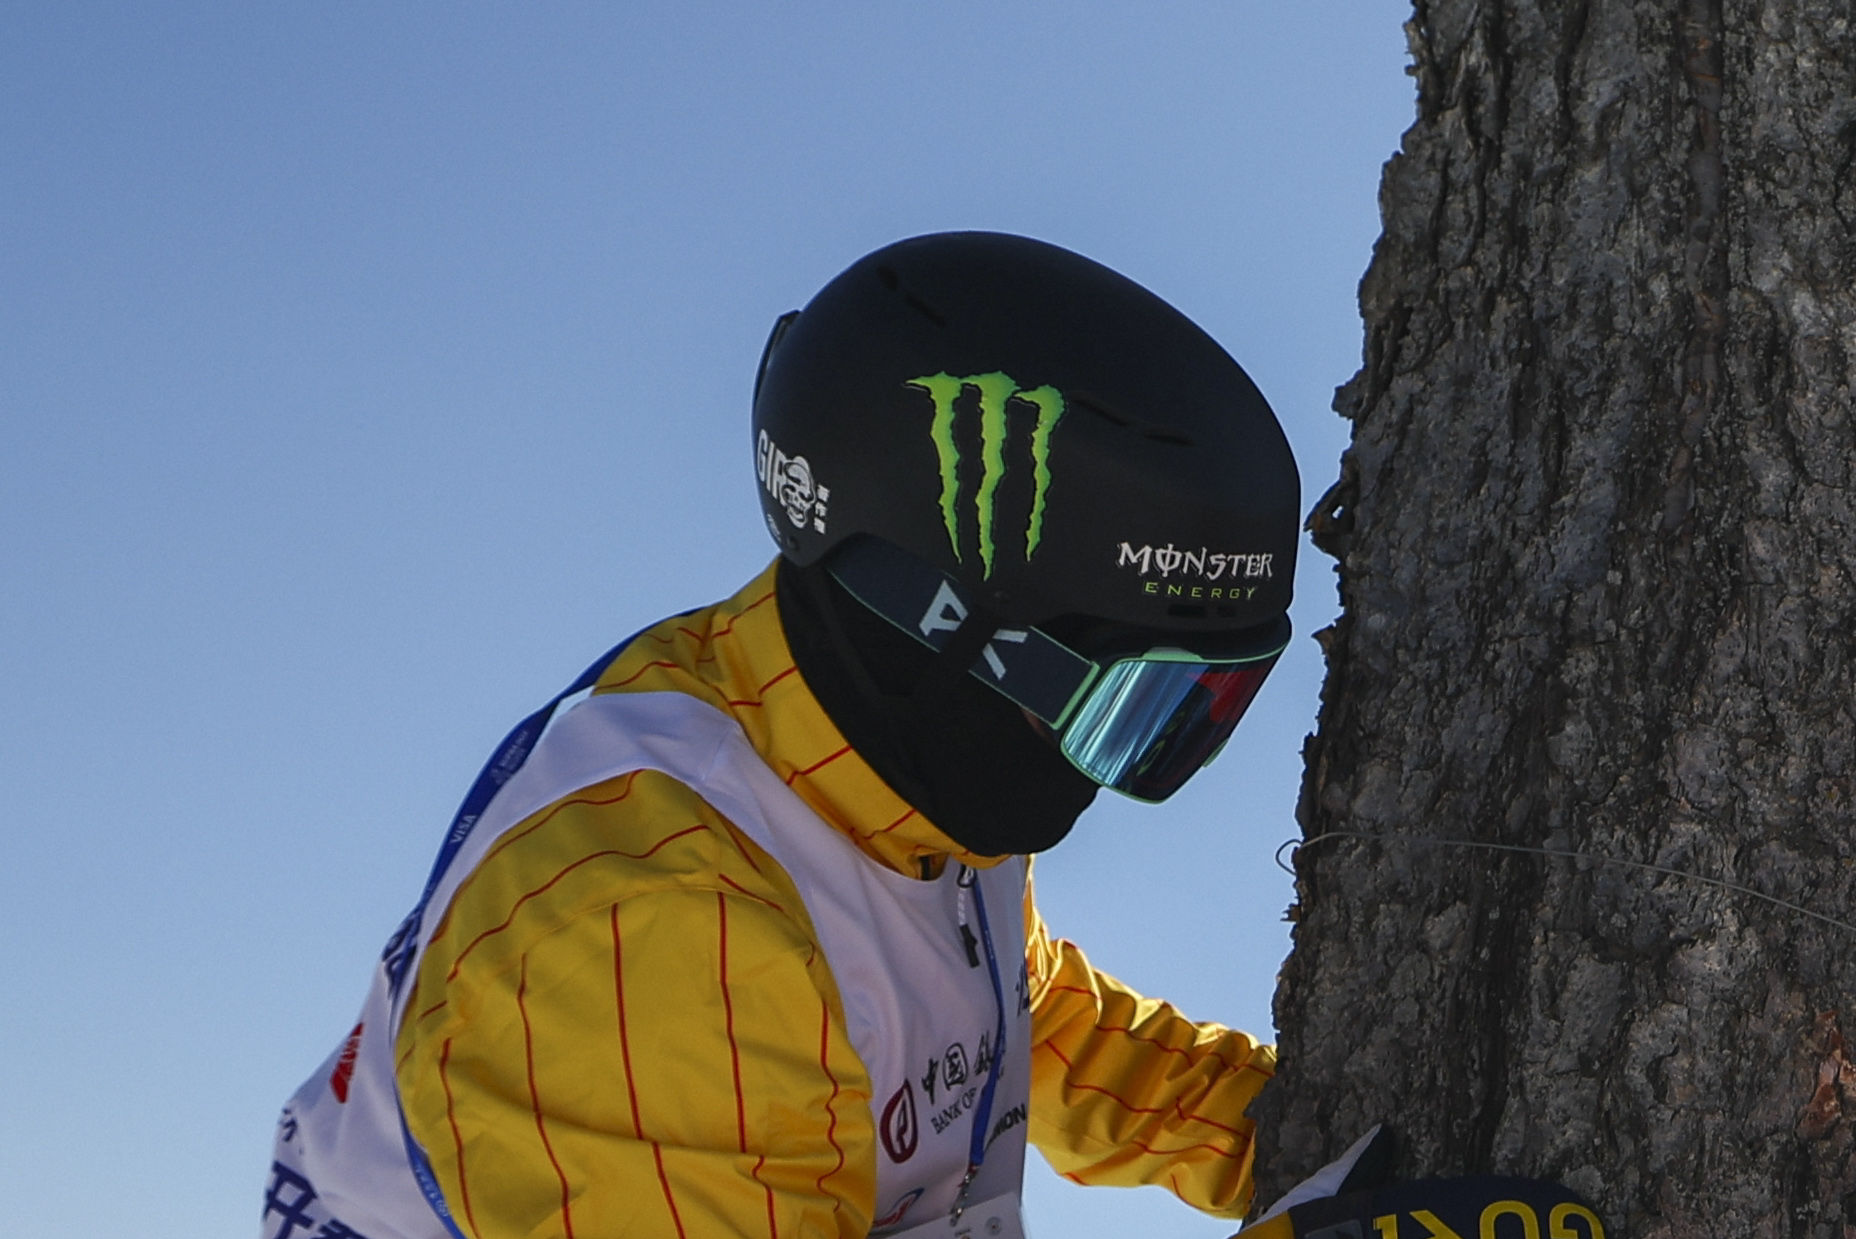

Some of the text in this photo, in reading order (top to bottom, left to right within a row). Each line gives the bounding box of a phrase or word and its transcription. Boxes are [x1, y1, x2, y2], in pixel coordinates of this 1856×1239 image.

[1144, 582, 1256, 600] ENERGY
[450, 814, 477, 844] VISA
[930, 1086, 978, 1135] BANK OF
